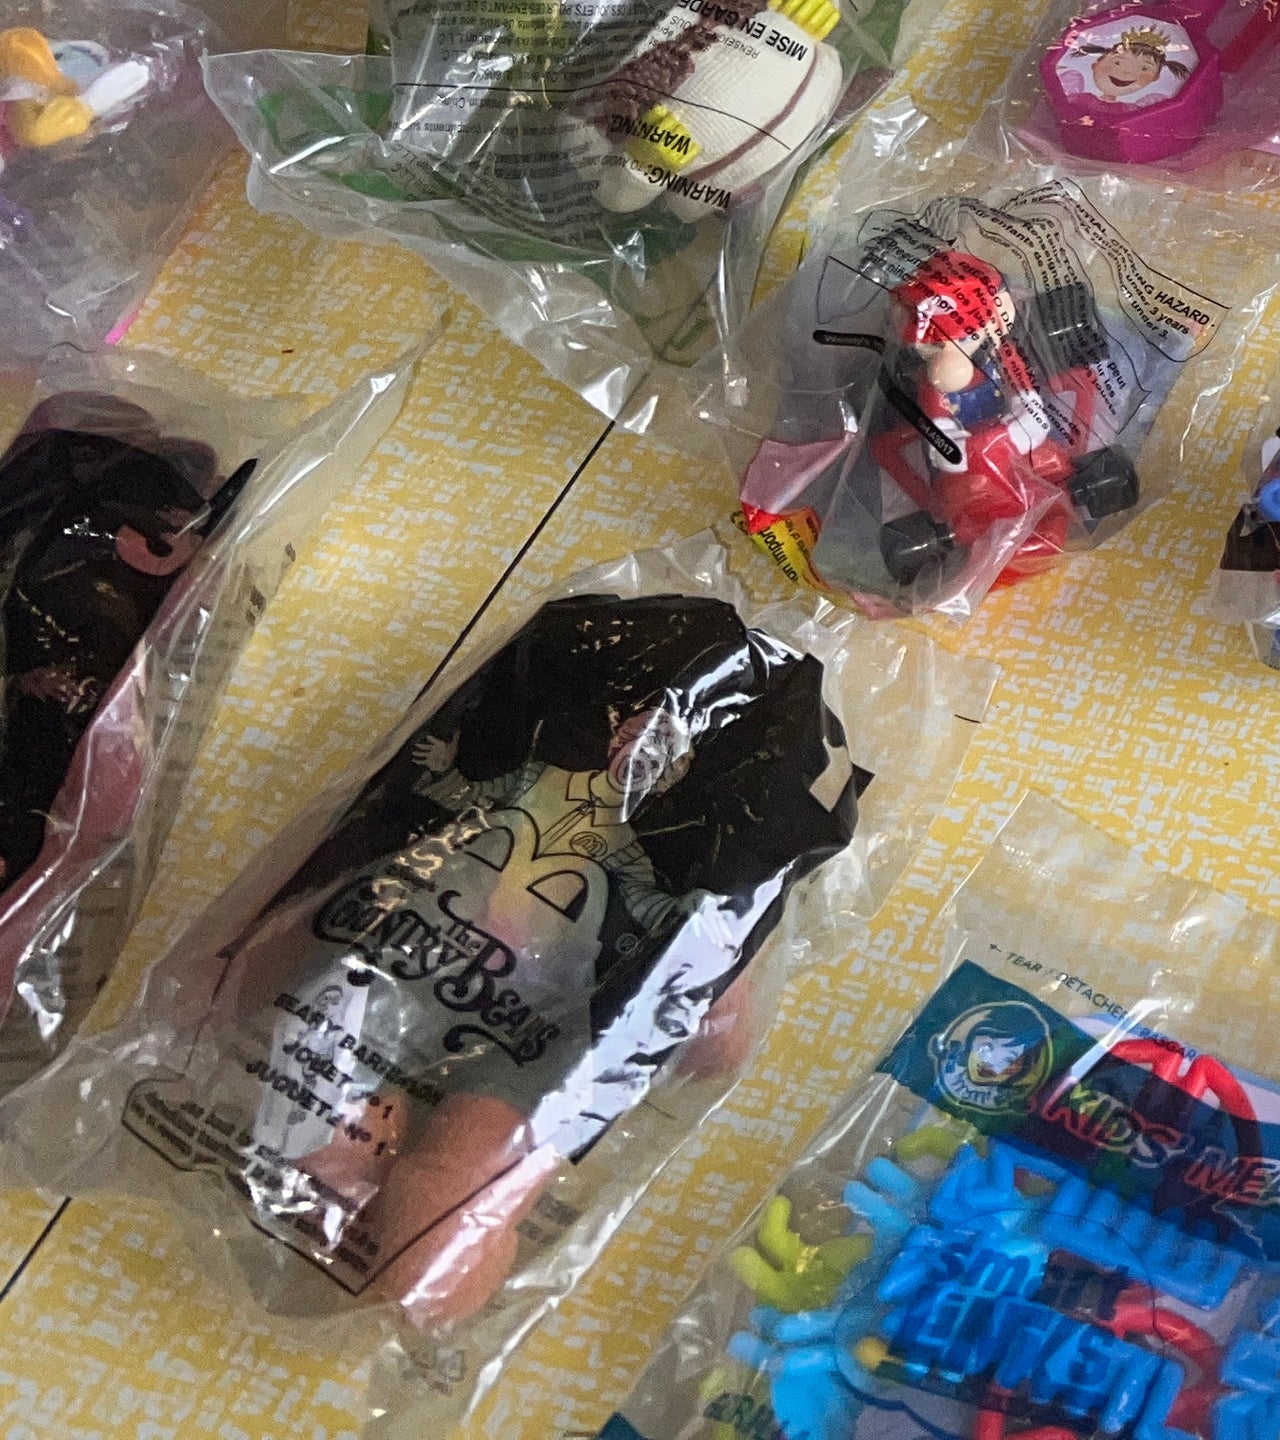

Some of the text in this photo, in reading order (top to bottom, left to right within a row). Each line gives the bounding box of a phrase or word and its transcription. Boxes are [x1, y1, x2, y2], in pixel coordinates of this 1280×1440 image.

[737, 16, 766, 38] EN
[768, 26, 808, 61] MISE
[642, 161, 731, 209] WARNING:
[1154, 290, 1210, 328] HAZARD
[1156, 311, 1189, 336] years
[1005, 949, 1045, 975] TEAR
